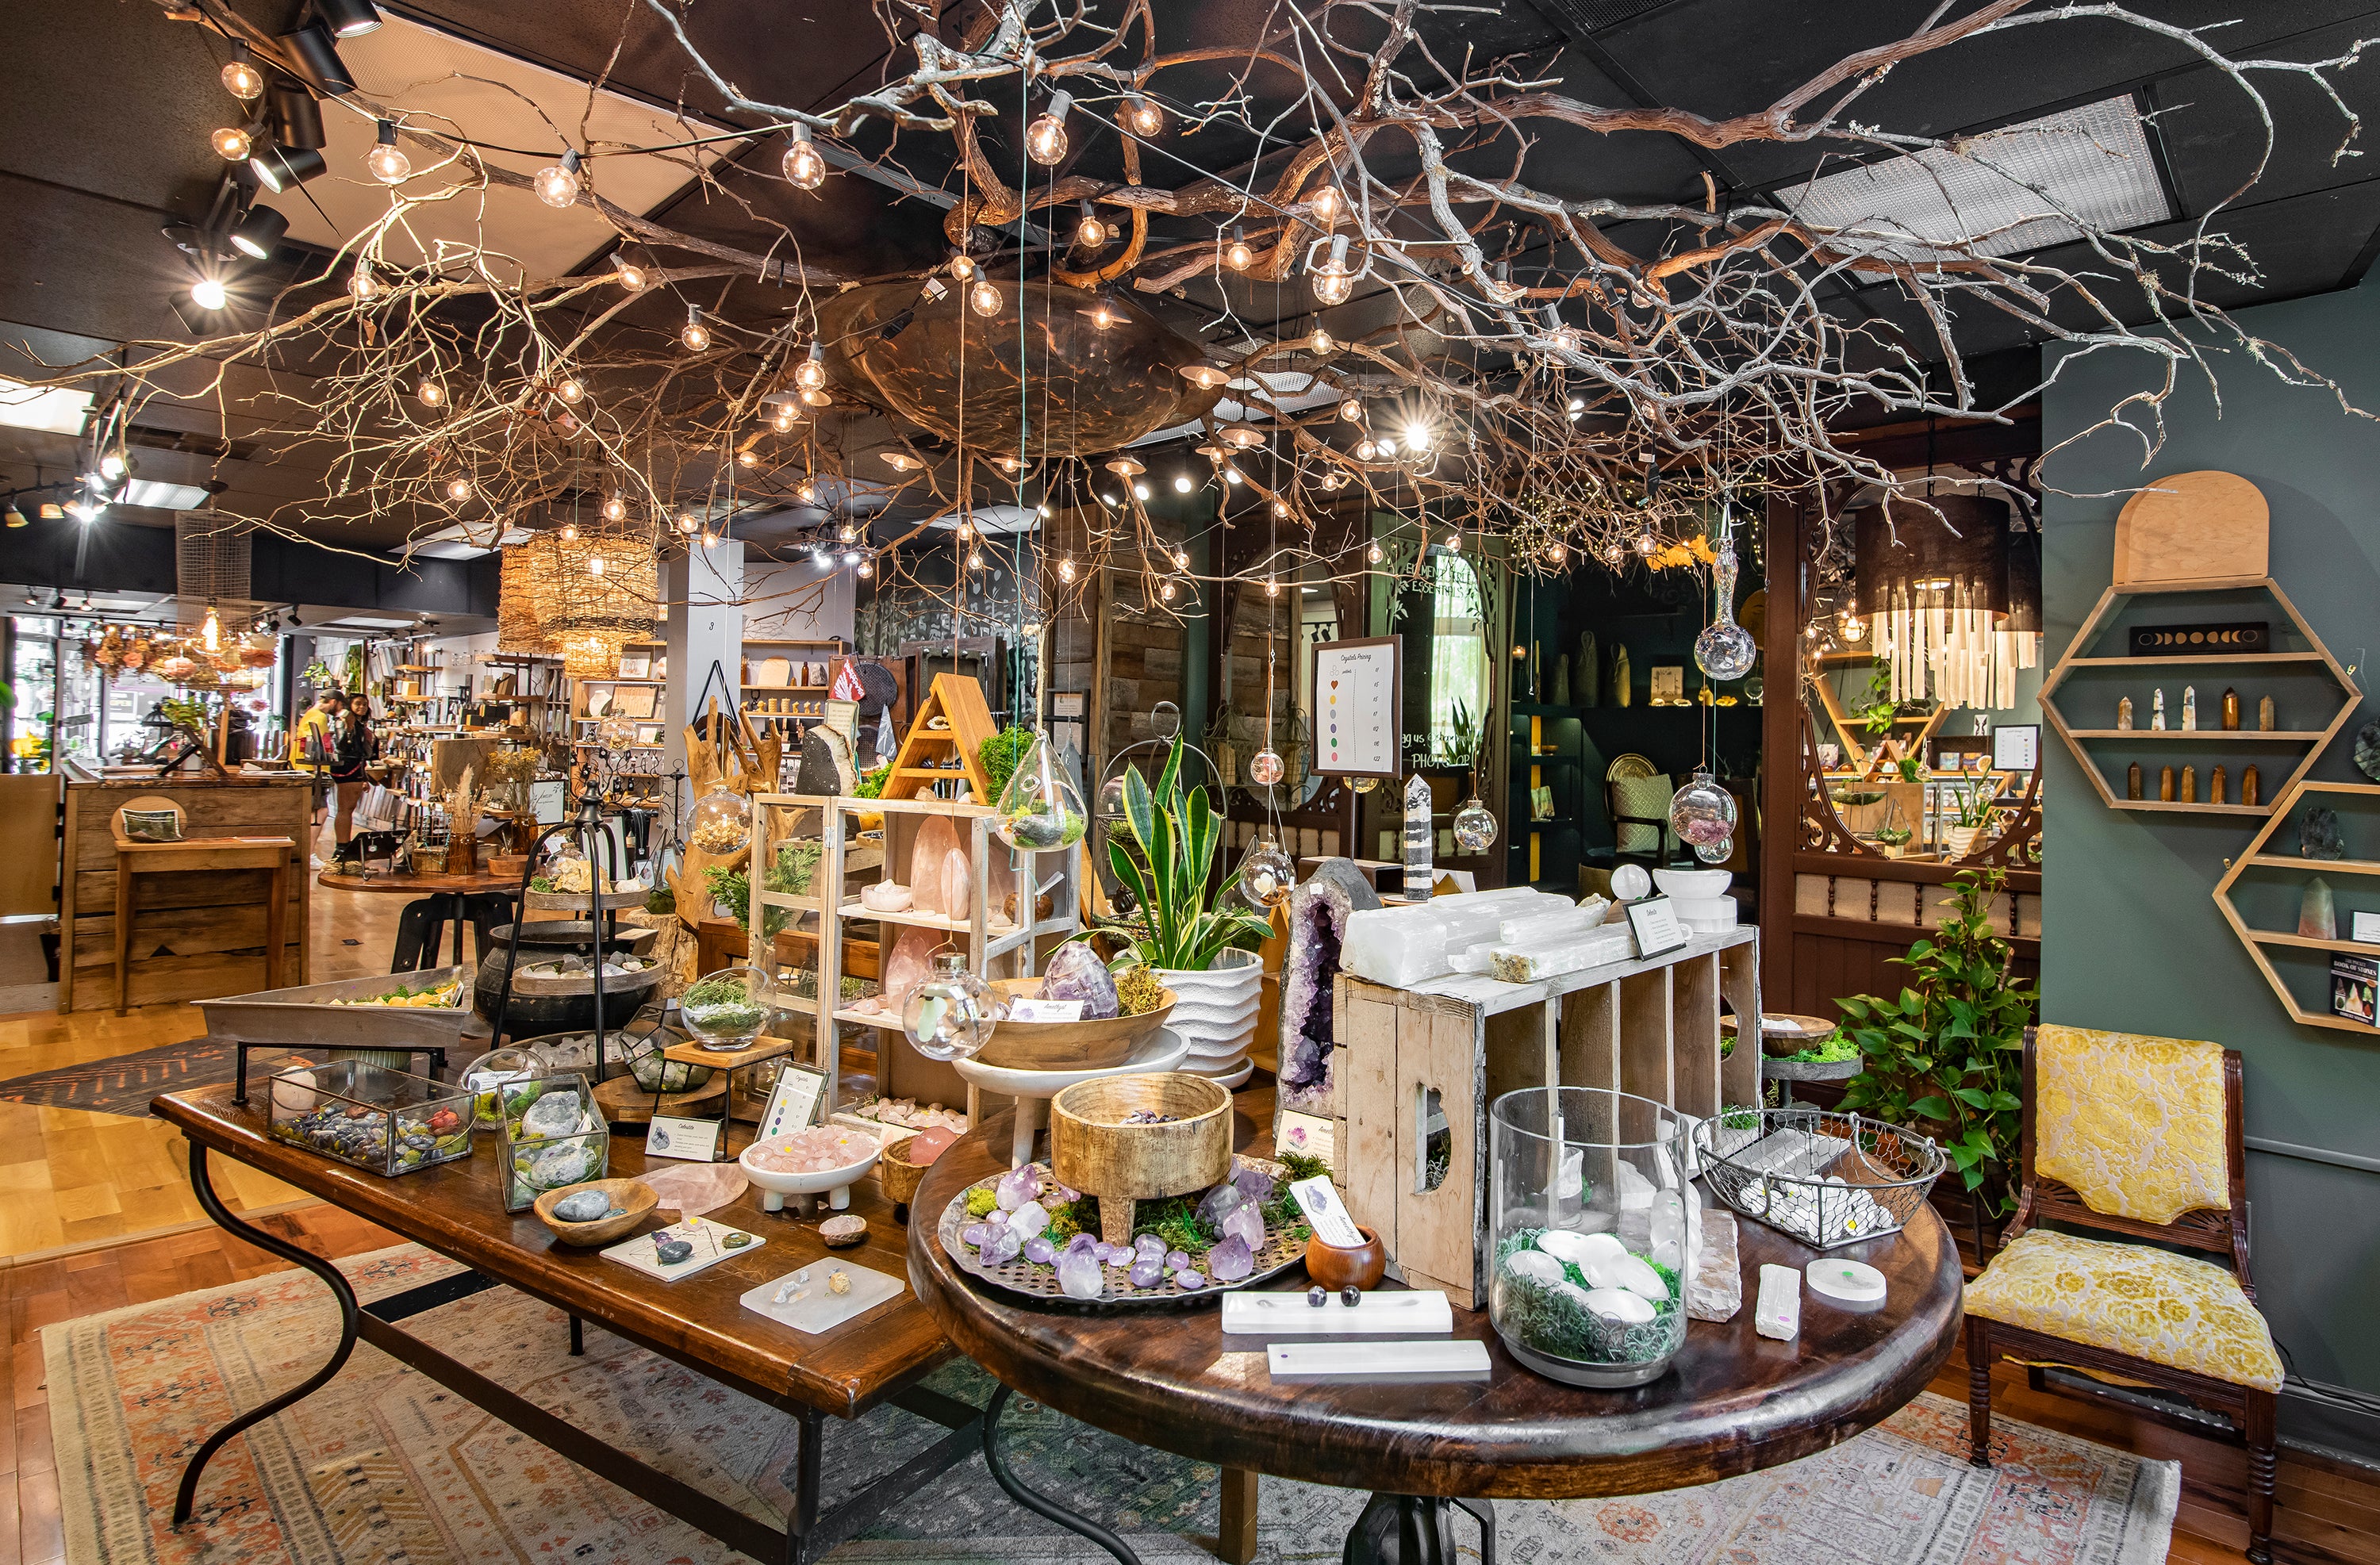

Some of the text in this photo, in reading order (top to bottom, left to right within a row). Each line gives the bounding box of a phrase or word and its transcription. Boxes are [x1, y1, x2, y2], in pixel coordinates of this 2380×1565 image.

[1357, 654, 1372, 662] Pricing
[2334, 960, 2349, 969] BOOK
[2358, 966, 2377, 976] STONES
[1044, 1003, 1067, 1012] Amethyst
